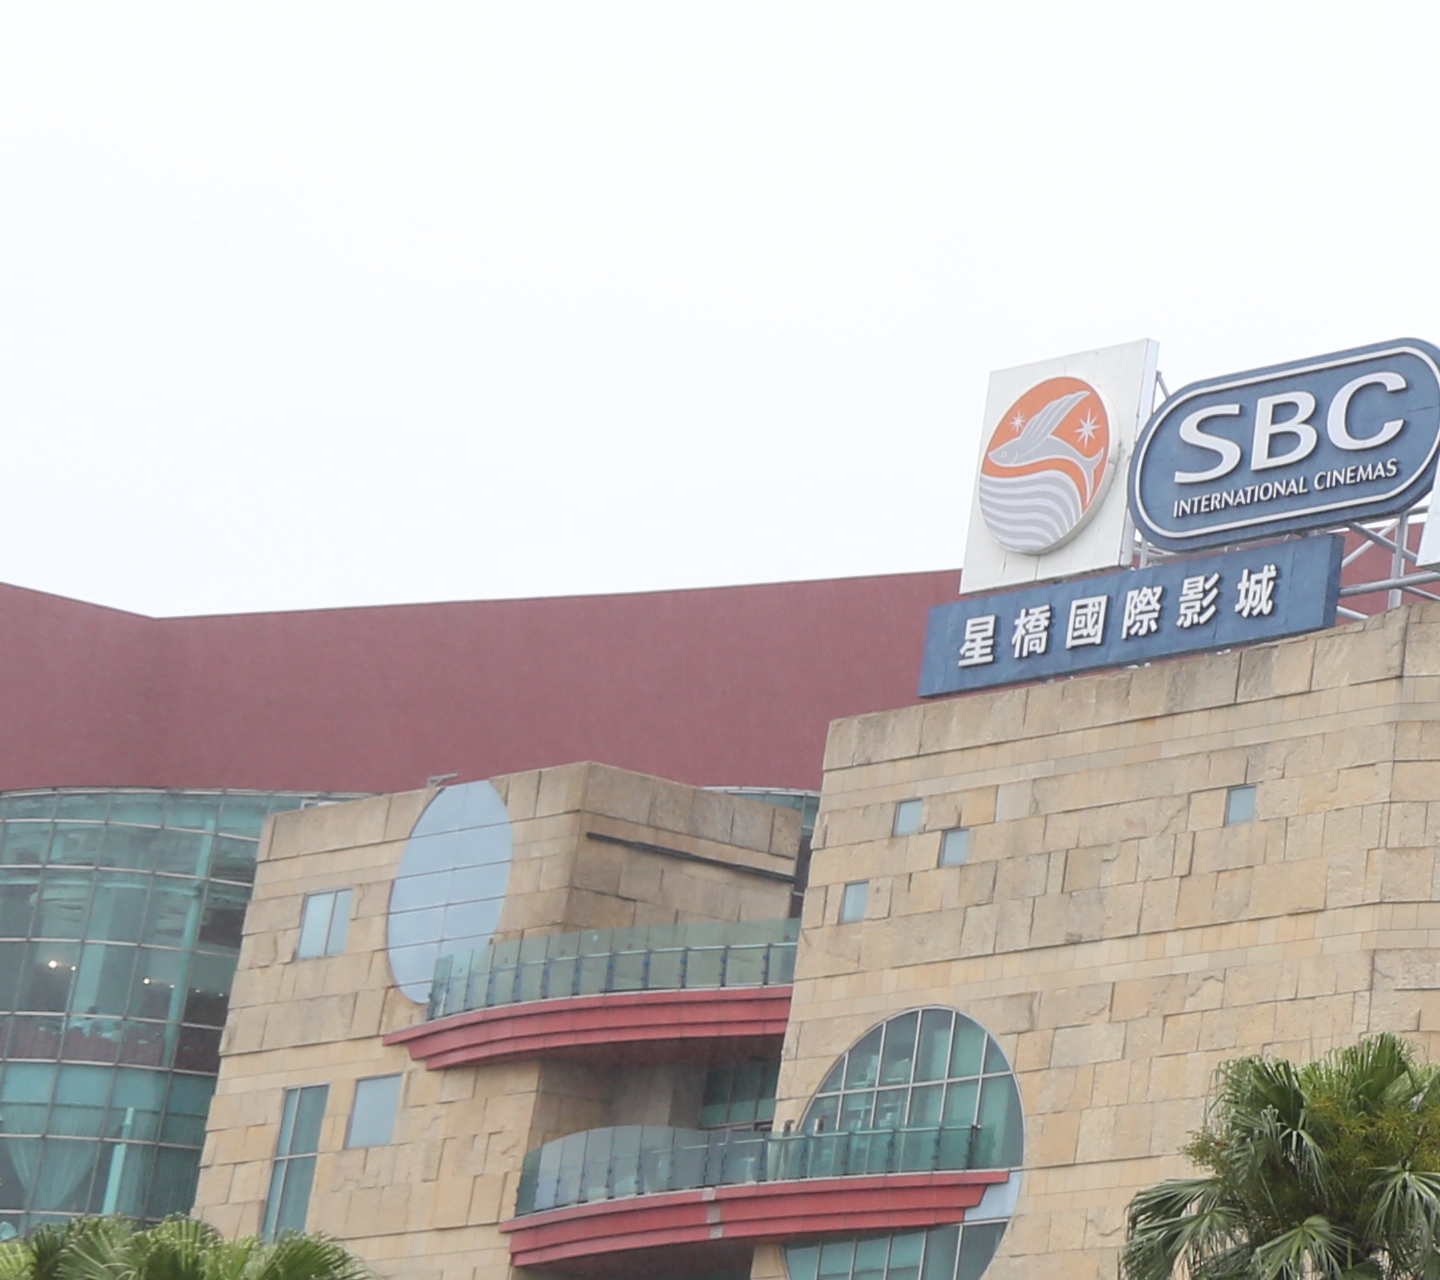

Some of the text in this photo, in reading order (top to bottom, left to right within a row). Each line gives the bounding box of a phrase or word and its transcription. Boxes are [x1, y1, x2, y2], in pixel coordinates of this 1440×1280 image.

[1173, 370, 1408, 485] SBC
[1172, 457, 1399, 519] INTERNATIONAL CINEMAS
[957, 562, 1279, 669] 星橋國際影城
